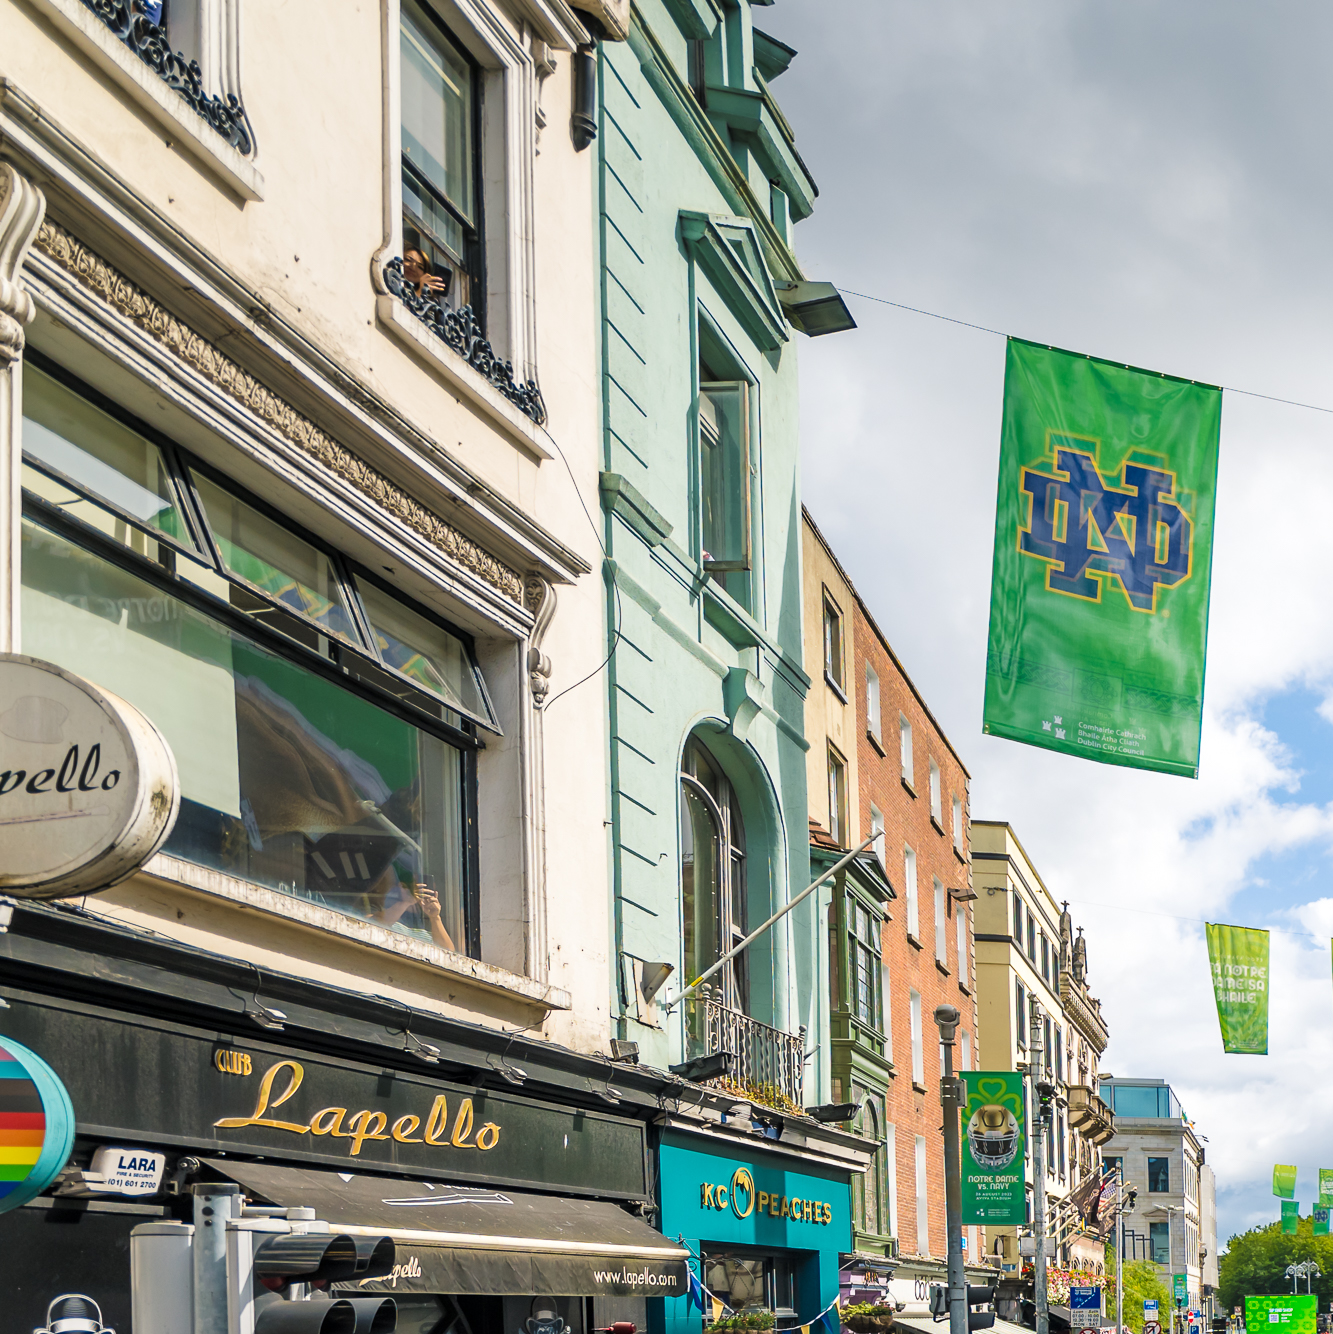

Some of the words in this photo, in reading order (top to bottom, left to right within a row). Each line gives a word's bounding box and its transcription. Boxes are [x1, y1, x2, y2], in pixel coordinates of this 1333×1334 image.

[1078, 730, 1100, 739] Bhaile
[1102, 734, 1117, 743] Átha
[1119, 738, 1139, 747] Cliath
[1079, 722, 1114, 734] Comhairle
[1116, 730, 1146, 740] Cathrach
[1078, 738, 1101, 748] Dublin
[1103, 744, 1117, 752] City
[1118, 746, 1144, 756] Council
[1249, 980, 1264, 990] SA
[214, 1049, 252, 1075] CLUB
[213, 1061, 501, 1155] Lapello
[118, 1156, 155, 1172] LARA
[108, 1179, 122, 1187] (01)
[703, 1183, 728, 1209] KC
[757, 1191, 832, 1224] PEACHES
[594, 1267, 677, 1289] www.lapello.com
